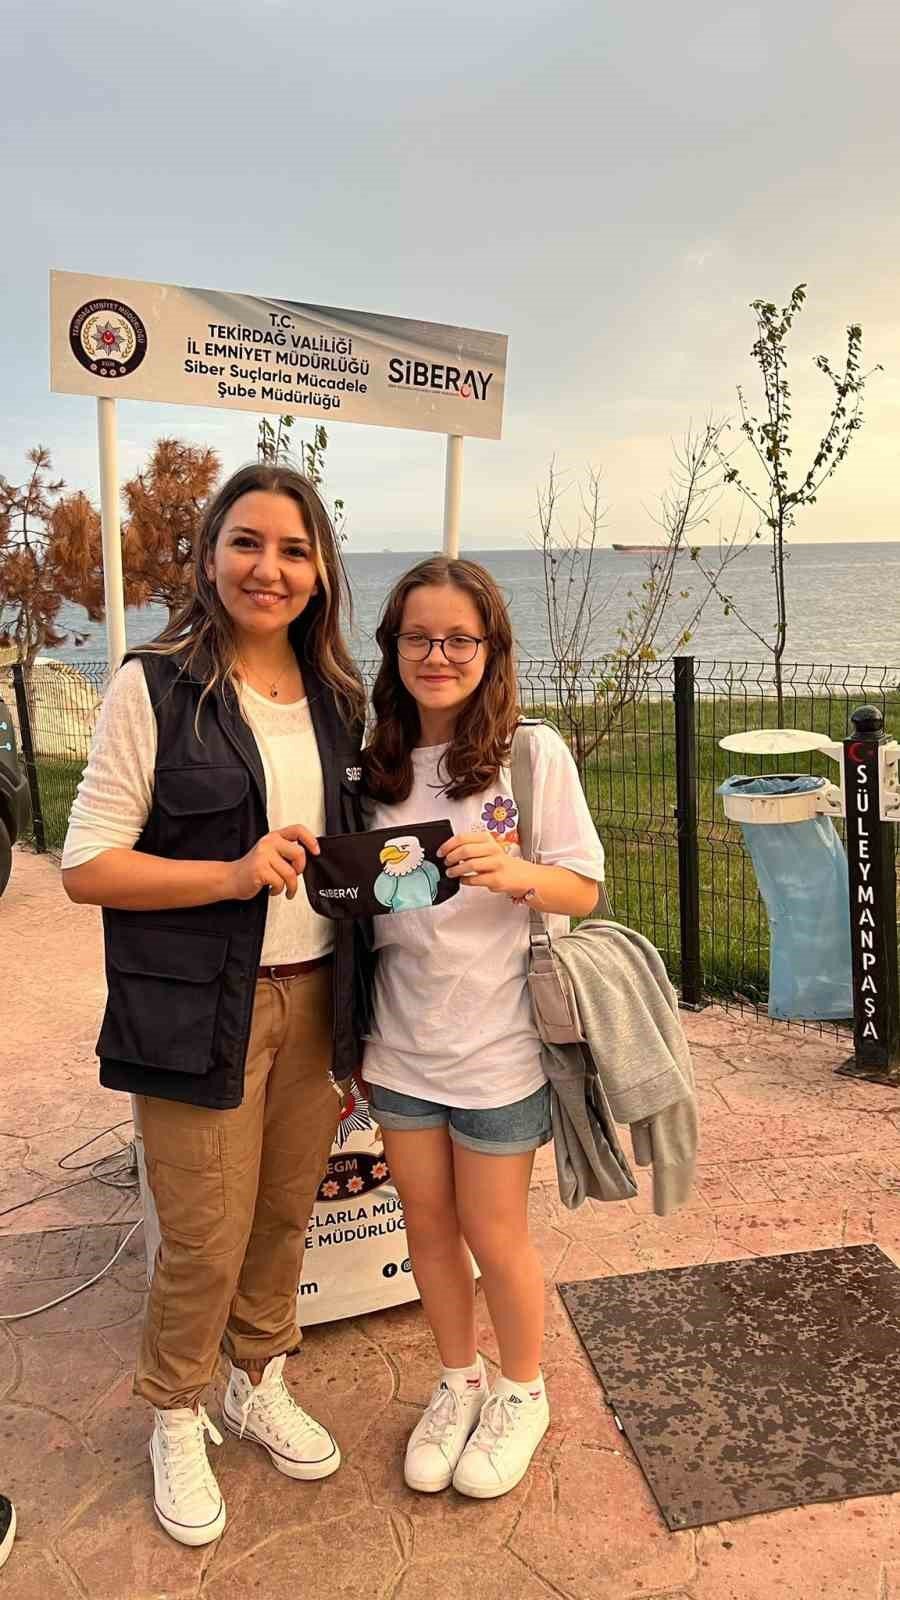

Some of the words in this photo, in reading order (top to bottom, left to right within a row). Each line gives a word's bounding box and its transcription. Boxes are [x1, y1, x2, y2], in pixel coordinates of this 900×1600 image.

[269, 313, 295, 329] T.C.
[208, 324, 287, 346] TEKİRDAĞ
[291, 335, 352, 355] VALİLİĞİ
[187, 337, 200, 355] İL
[205, 342, 271, 363] EMNİYET
[276, 351, 369, 376] MÜDÜRLÜĞÜ
[184, 359, 225, 376] Siber
[230, 364, 292, 384] Suçlarla
[296, 373, 368, 394] Mücadele
[217, 381, 256, 399] Şube
[261, 386, 341, 410] Müdürlüğü
[856, 764, 878, 1041] SÜLEYMANPAŞA
[327, 1158, 358, 1174] EGM
